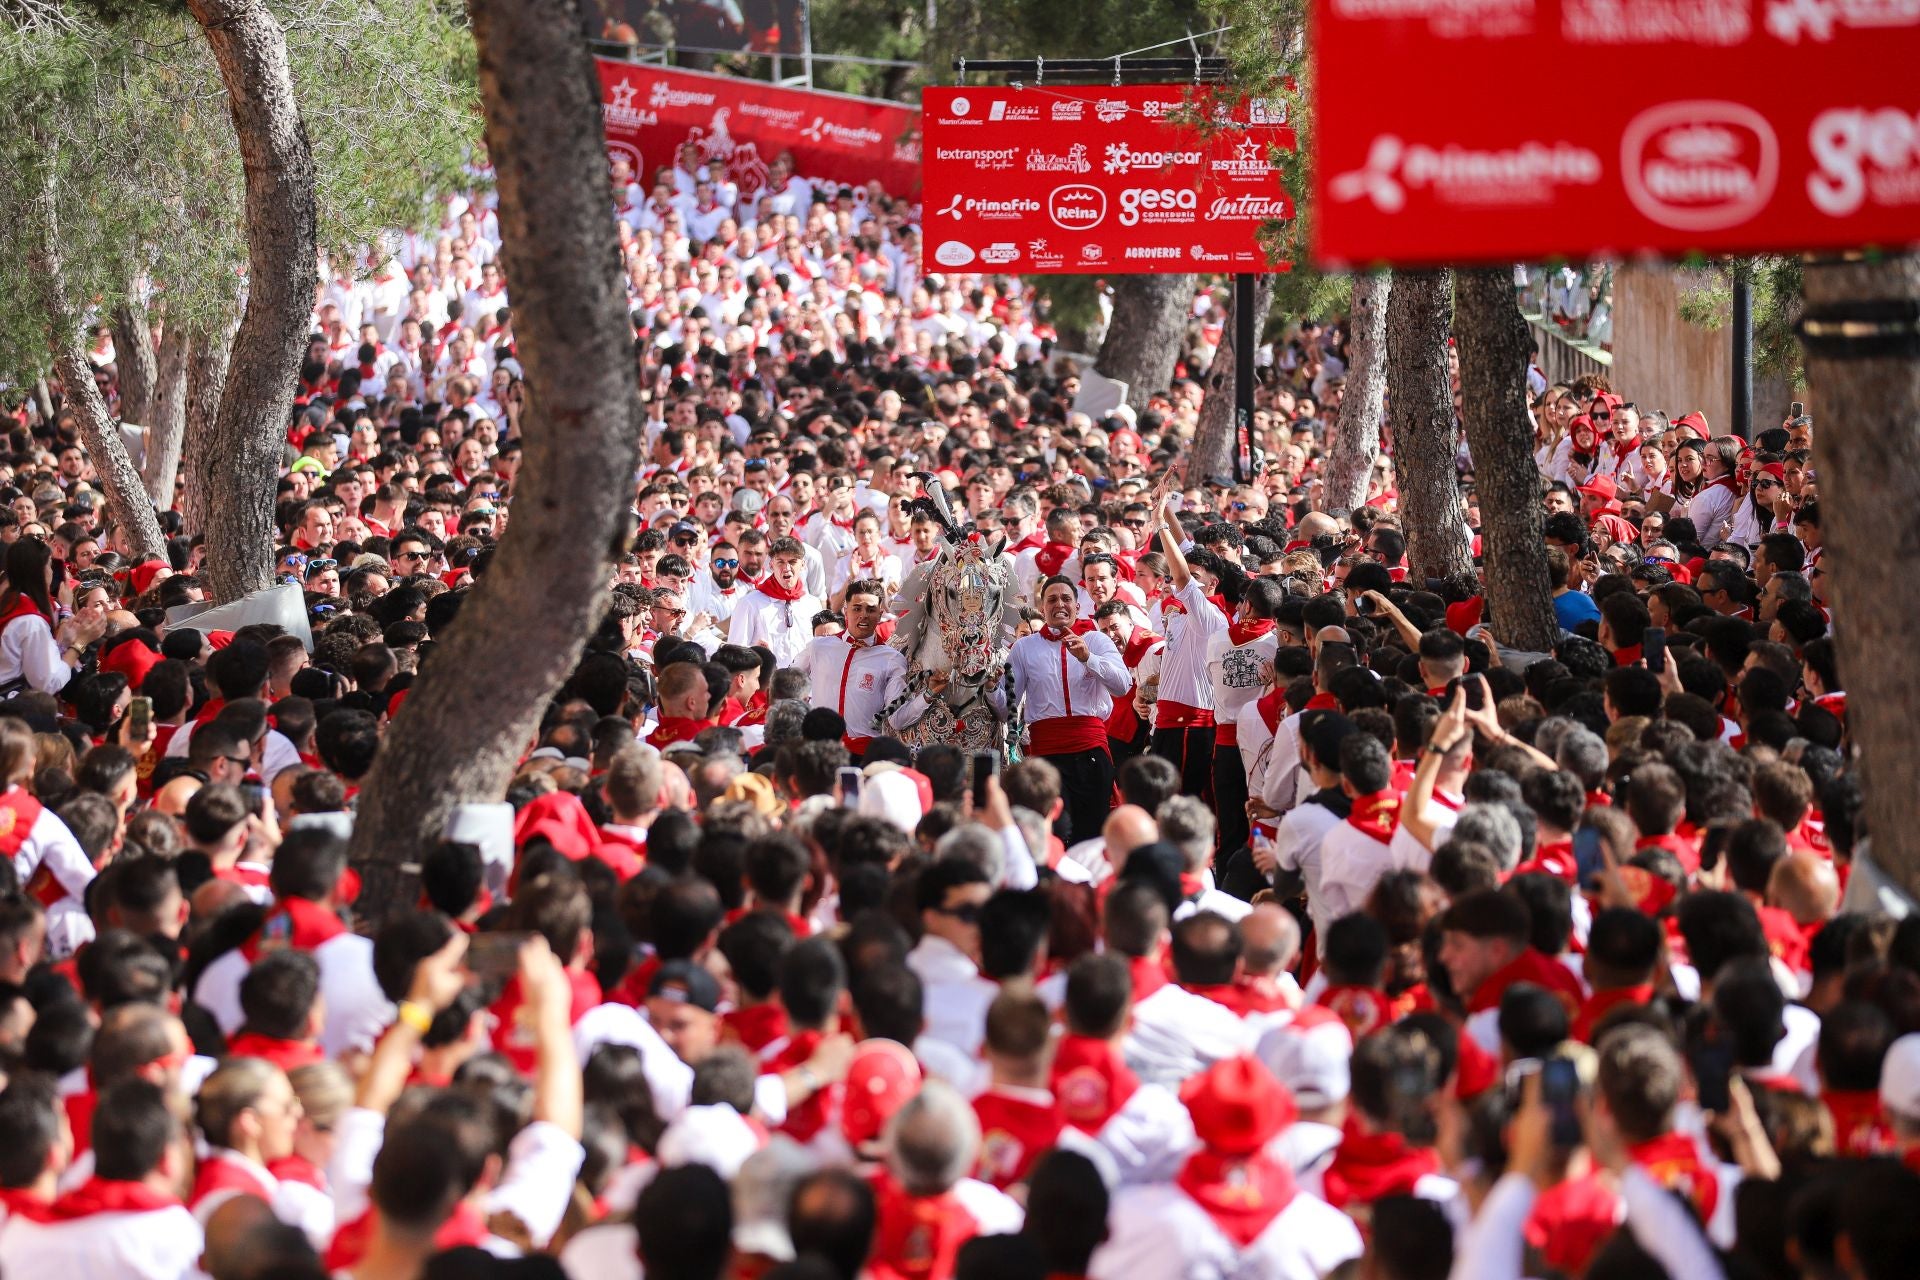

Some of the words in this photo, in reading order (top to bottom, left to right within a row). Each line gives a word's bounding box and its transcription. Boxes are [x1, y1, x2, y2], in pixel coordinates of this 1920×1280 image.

[1052, 101, 1083, 112] Coca-Cola
[937, 147, 1013, 163] lextransport
[1027, 154, 1056, 163] CRUZ
[1115, 150, 1202, 169] Congecar
[1026, 163, 1075, 171] PEREGRINO
[965, 198, 1041, 212] PrimaFrio
[1119, 188, 1197, 227] gesa
[1204, 193, 1283, 221] Intusa
[1056, 206, 1098, 220] Reina
[1142, 211, 1196, 219] CORREDURÍA
[1125, 247, 1181, 259] AGROVERDE
[1202, 252, 1228, 261] ribera
